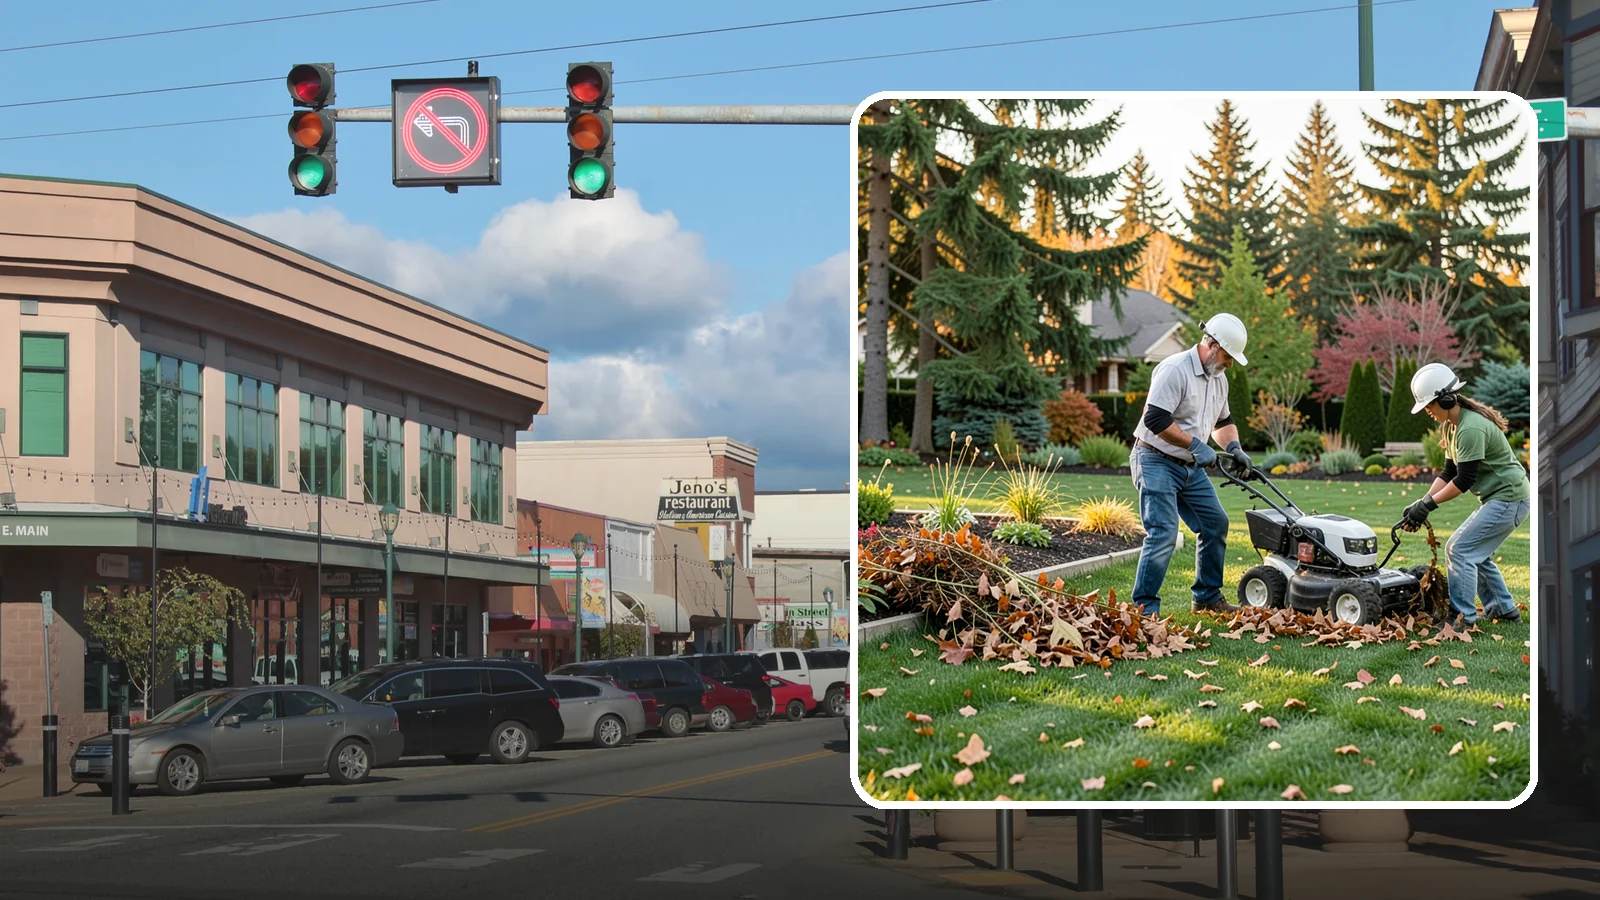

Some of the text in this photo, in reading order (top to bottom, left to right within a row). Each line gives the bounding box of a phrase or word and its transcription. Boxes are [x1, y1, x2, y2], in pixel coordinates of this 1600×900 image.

[670, 480, 728, 494] Jeno's
[665, 497, 731, 509] restaurant
[659, 510, 682, 520] Italian
[686, 510, 714, 520] American
[715, 510, 738, 520] Cuisine
[2, 525, 49, 536] E. MAIN
[797, 608, 828, 616] Street
